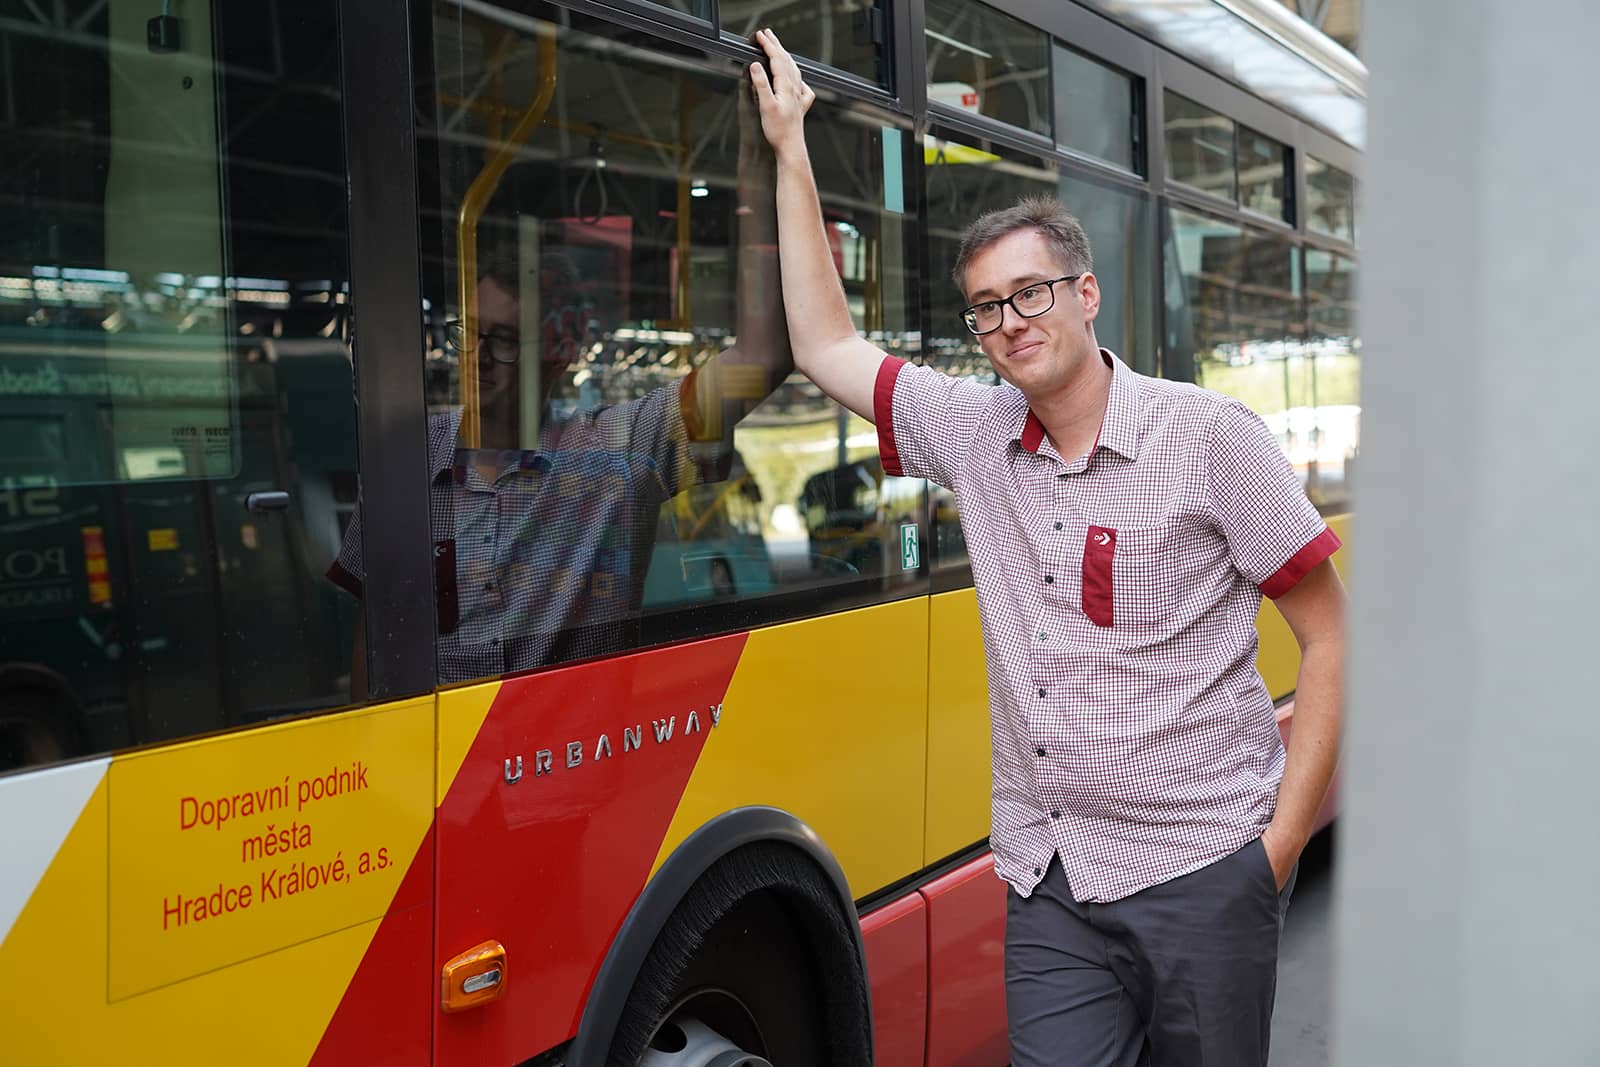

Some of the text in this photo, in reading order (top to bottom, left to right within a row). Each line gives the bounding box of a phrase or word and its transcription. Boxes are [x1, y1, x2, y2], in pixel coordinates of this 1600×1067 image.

[504, 703, 723, 785] URBANWAY
[180, 761, 369, 831] Dopravní podnik
[242, 822, 312, 863] města
[163, 846, 394, 931] Hradce Králové, a.s.
